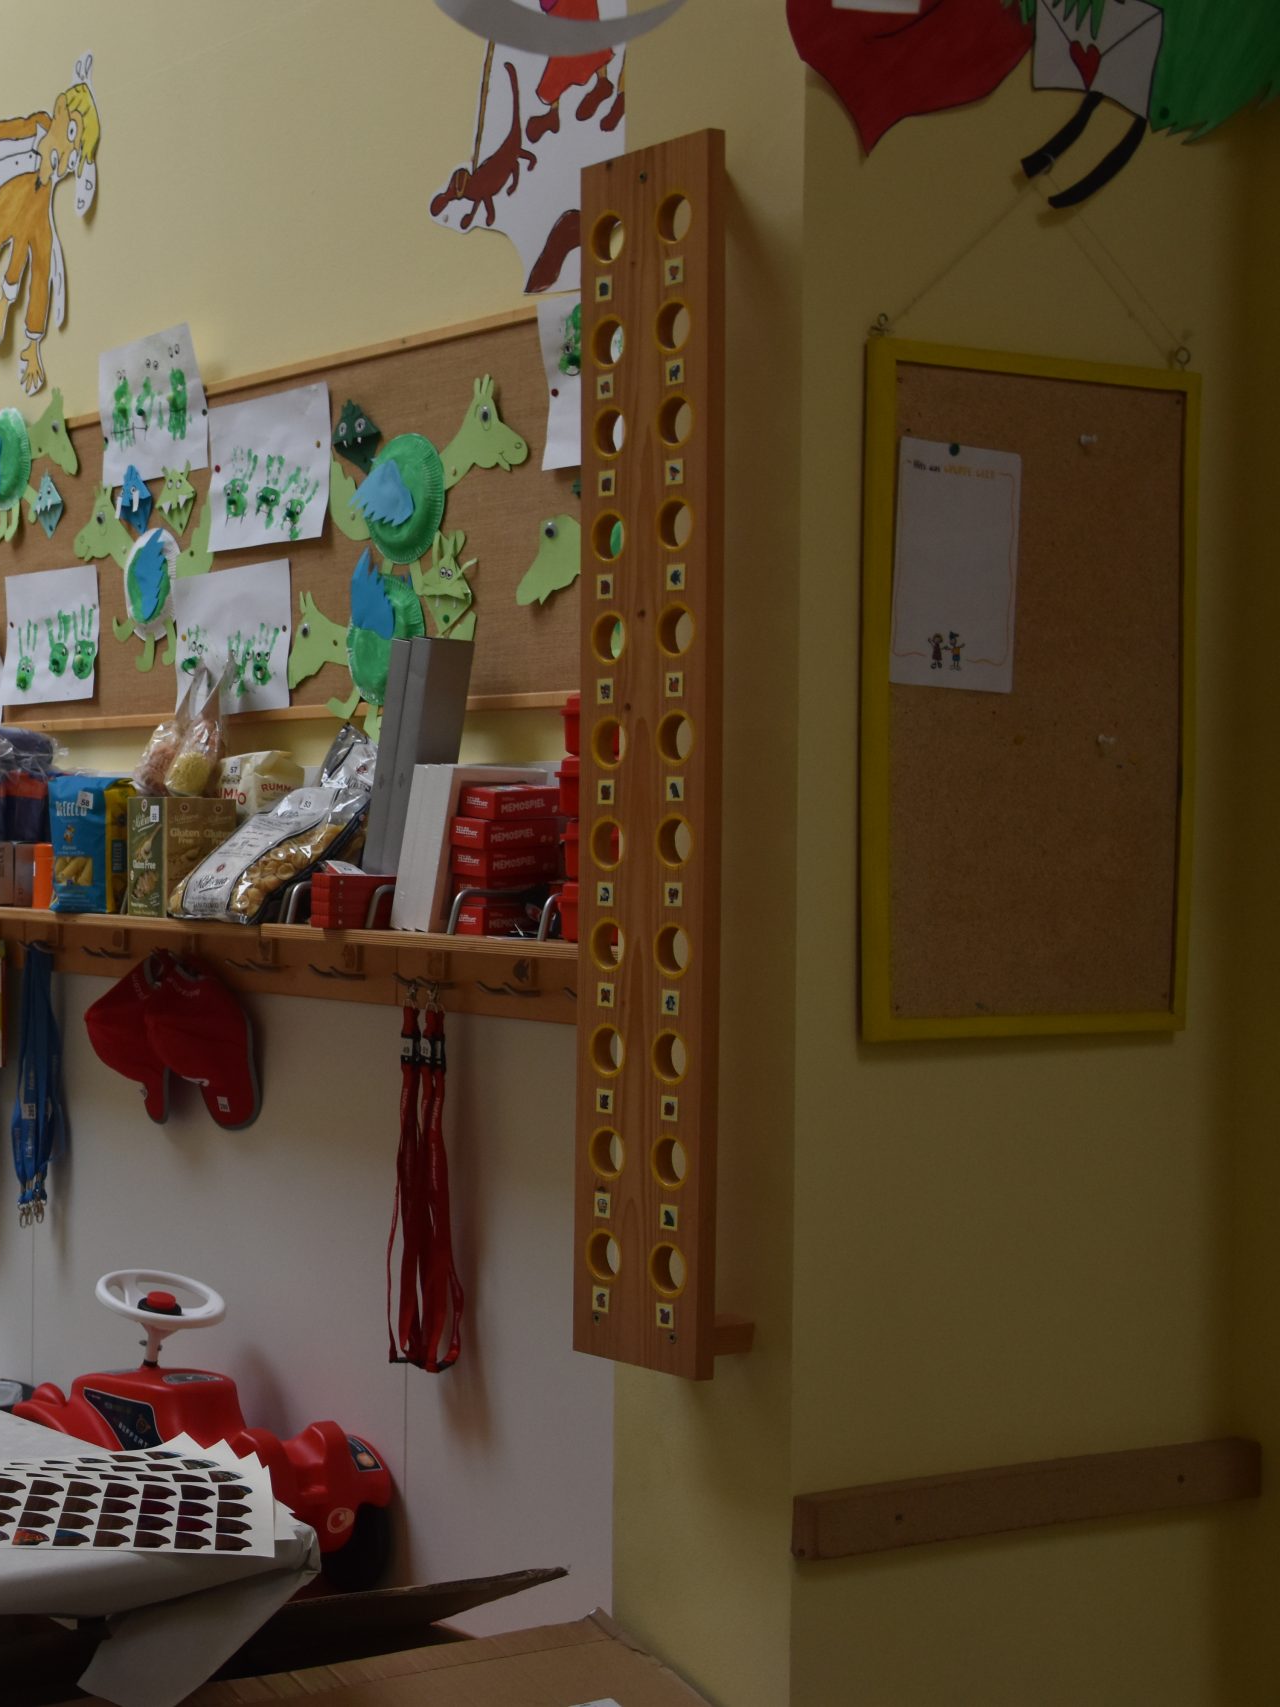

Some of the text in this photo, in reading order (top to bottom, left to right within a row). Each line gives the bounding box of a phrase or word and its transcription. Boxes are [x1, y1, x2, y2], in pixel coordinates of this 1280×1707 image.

[260, 782, 293, 793] RUMM
[79, 798, 90, 807] 58
[500, 798, 545, 815] MEMOSPIEL
[490, 828, 535, 844] MEMOSPIEL
[492, 856, 537, 872] MEMOSPIEL
